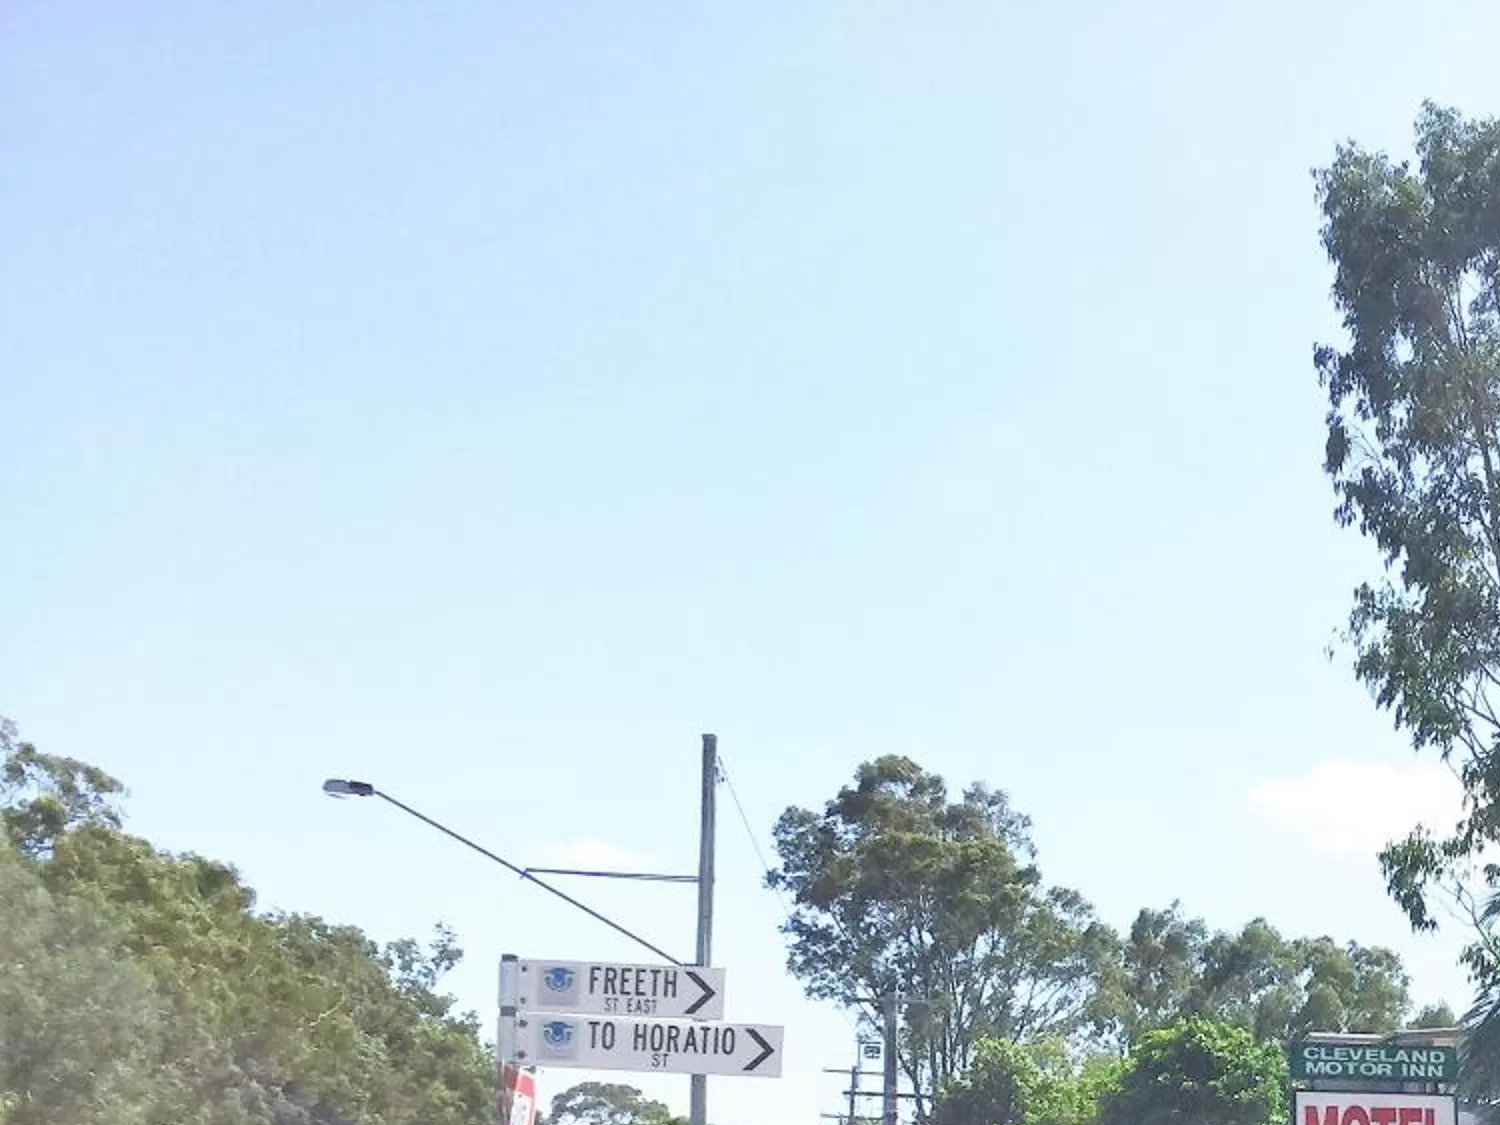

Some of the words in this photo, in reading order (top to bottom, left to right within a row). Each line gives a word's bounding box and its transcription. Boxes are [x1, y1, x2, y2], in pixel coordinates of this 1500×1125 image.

[589, 966, 678, 998] FREETH
[604, 998, 619, 1013] ST
[627, 999, 658, 1014] EAST
[588, 1021, 616, 1050] TO
[633, 1023, 735, 1055] HORATIO
[651, 1053, 669, 1068] ST
[1303, 1047, 1445, 1063] CLEVELAND
[1305, 1061, 1393, 1076] MOTOR
[1402, 1063, 1443, 1077] INN
